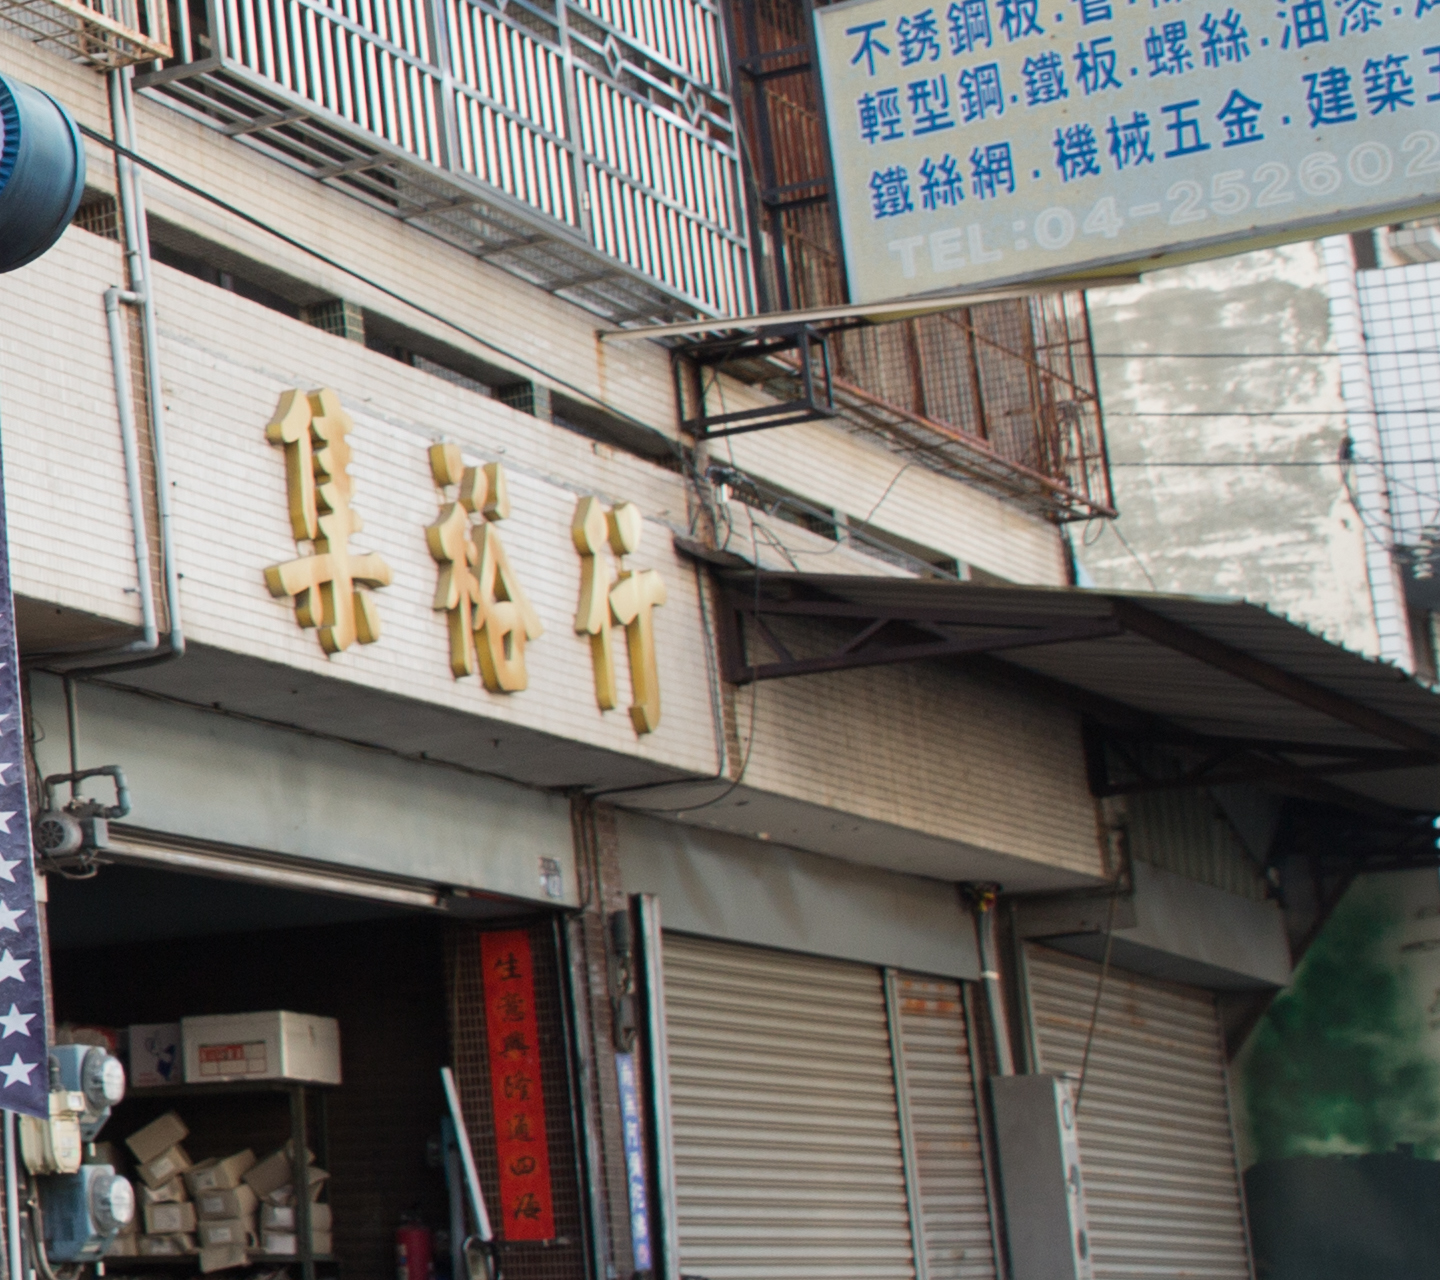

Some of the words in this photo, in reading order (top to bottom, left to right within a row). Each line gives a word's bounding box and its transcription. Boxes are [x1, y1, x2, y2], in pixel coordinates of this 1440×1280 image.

[263, 387, 668, 736] 集裕行
[494, 950, 544, 1223] 生意興隆通四海
